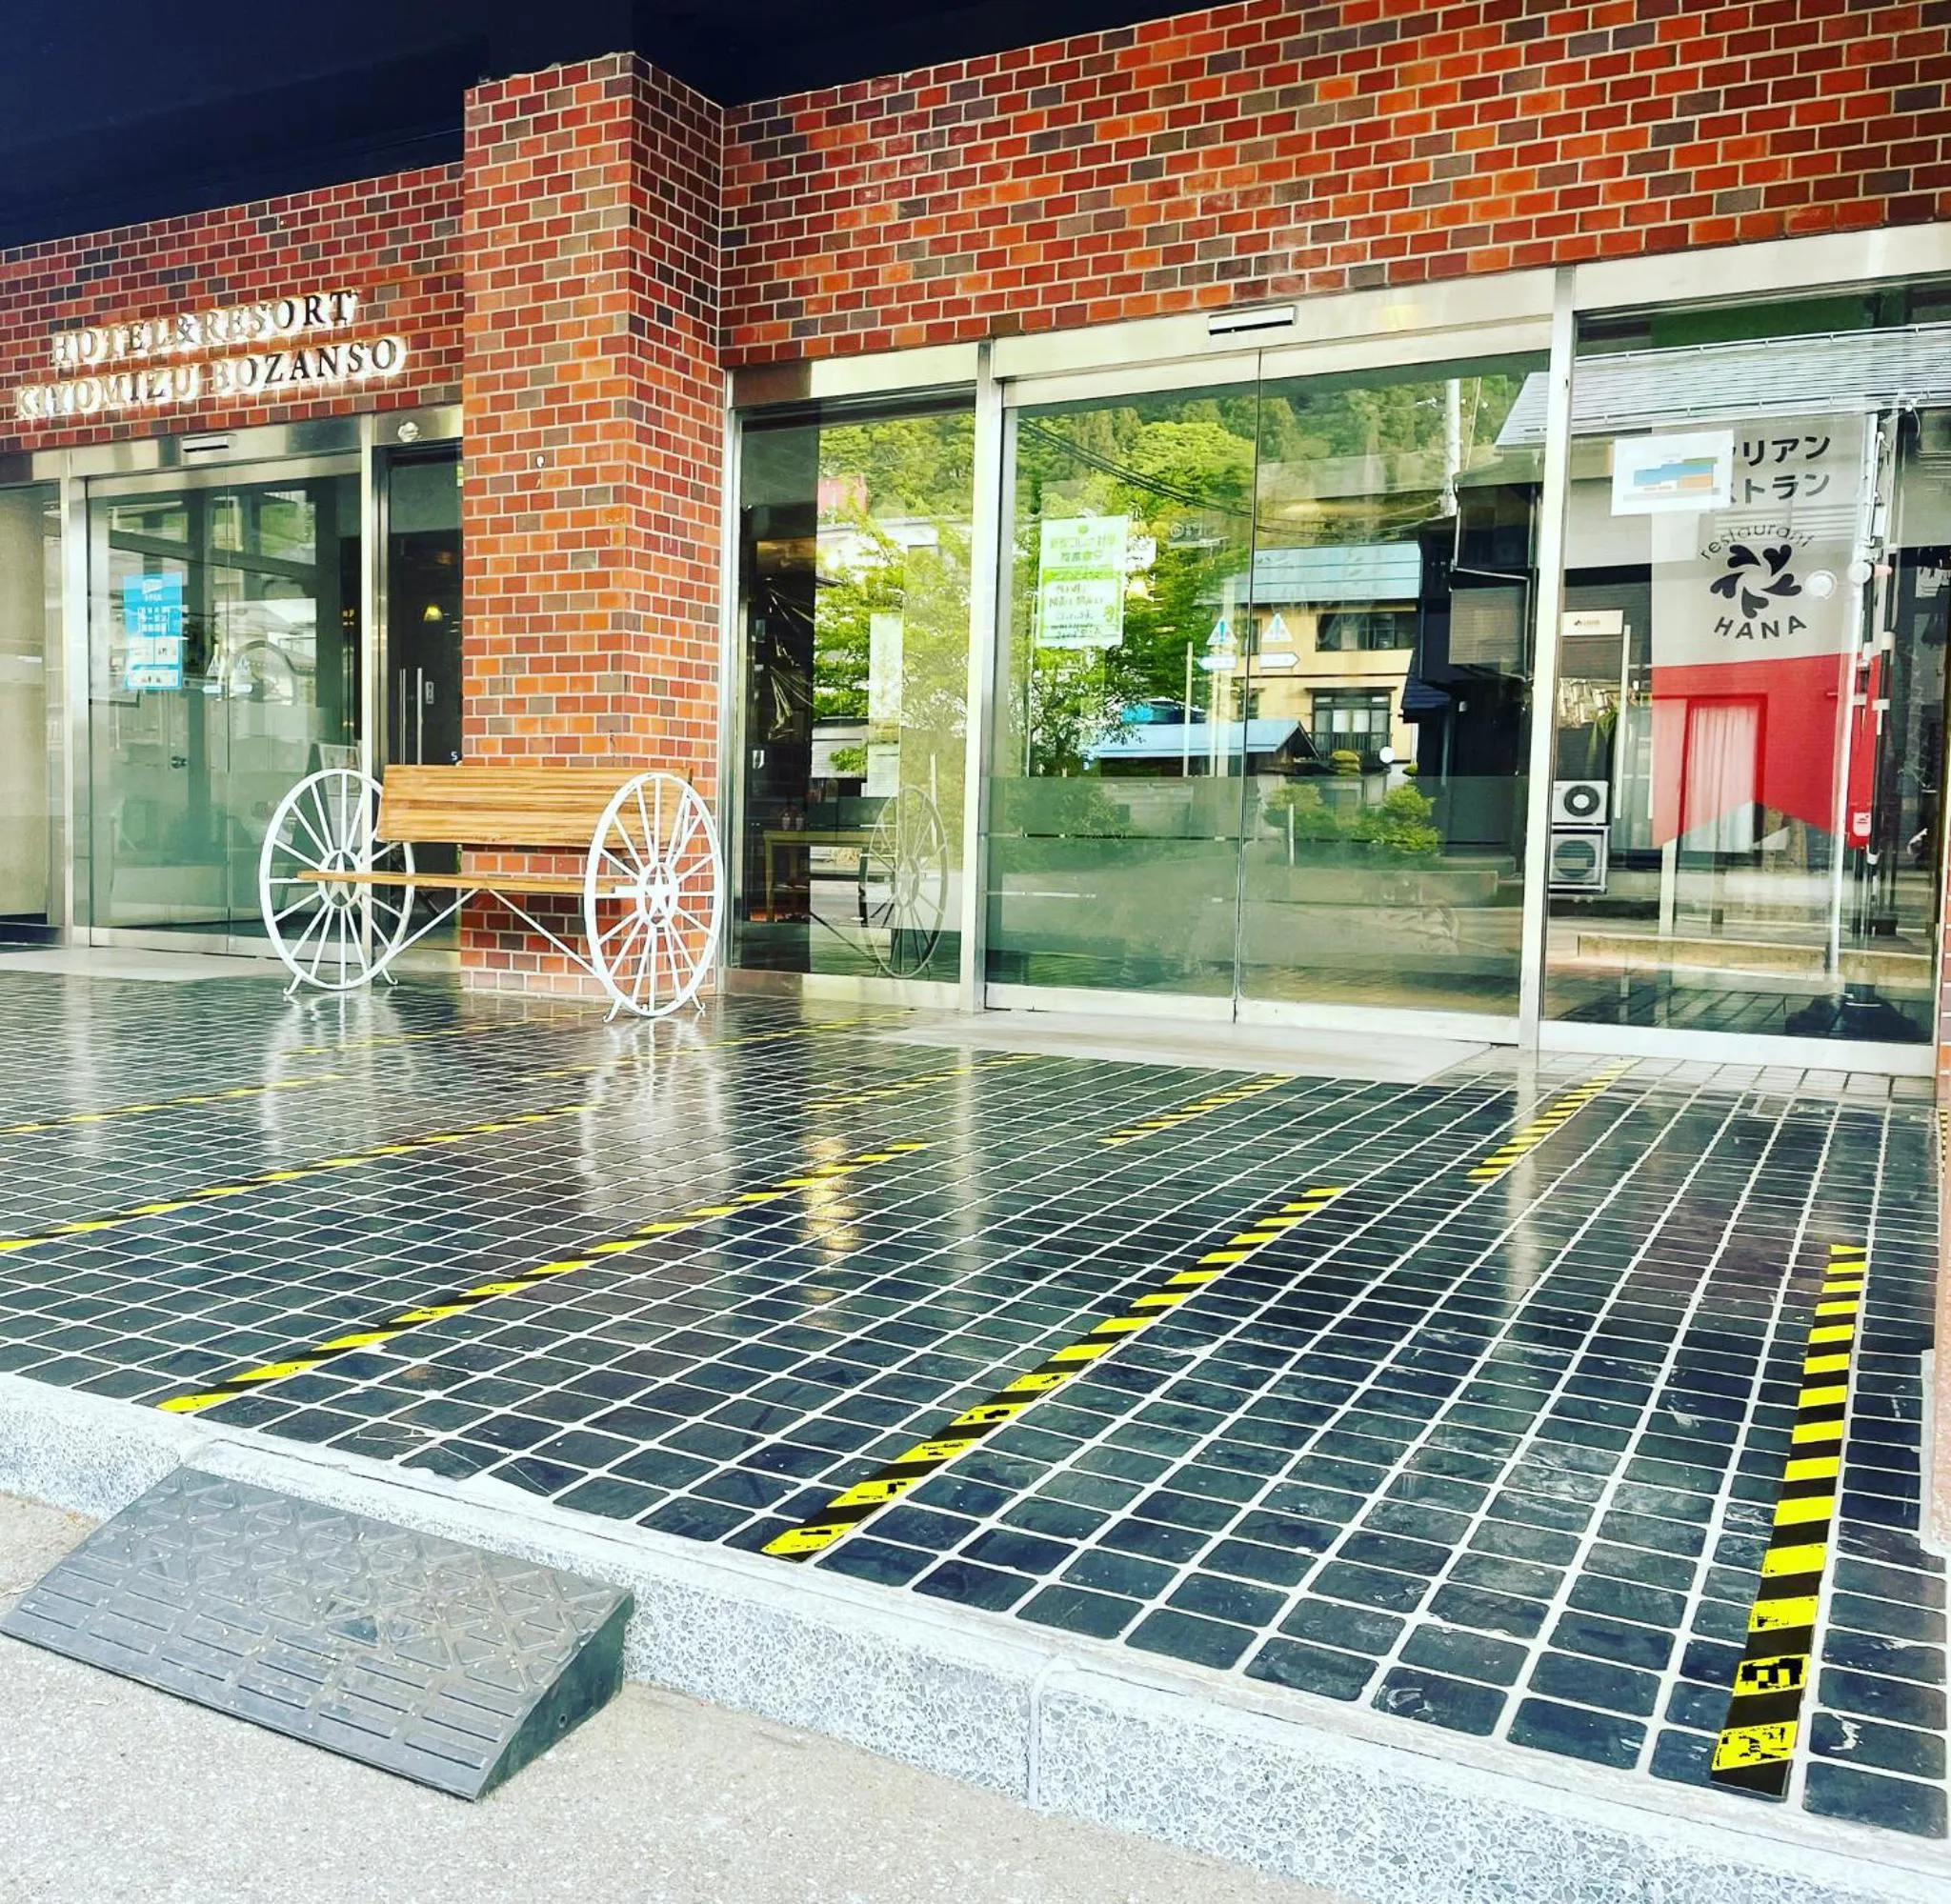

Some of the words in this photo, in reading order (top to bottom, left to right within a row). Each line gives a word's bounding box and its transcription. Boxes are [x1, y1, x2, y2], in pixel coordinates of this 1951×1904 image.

[15, 362, 200, 417] KIYOMIZU
[212, 338, 397, 392] BOZANSO
[1732, 436, 1831, 467] リアン
[1730, 473, 1831, 505] トラン
[1700, 524, 1815, 561] restaurant
[1714, 614, 1807, 639] HANA
